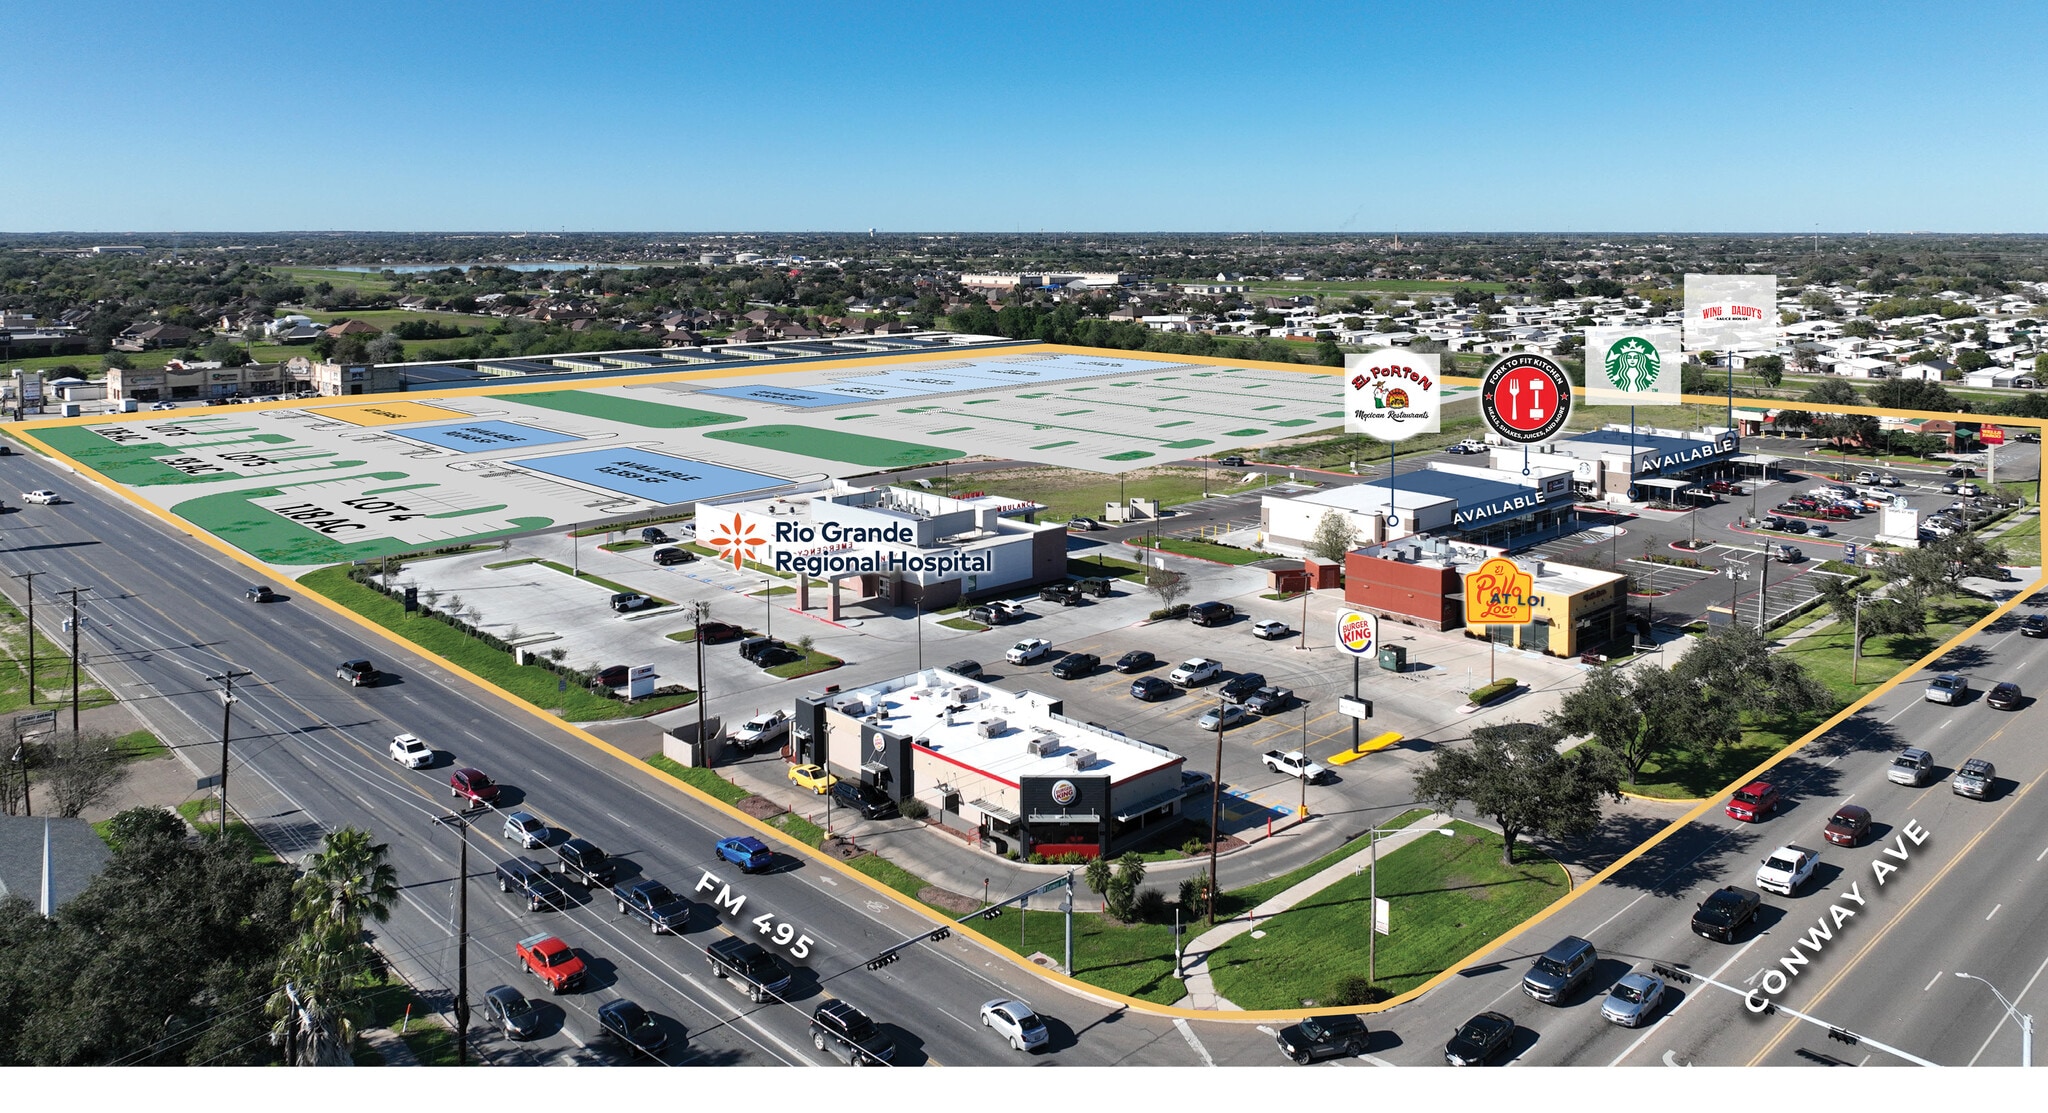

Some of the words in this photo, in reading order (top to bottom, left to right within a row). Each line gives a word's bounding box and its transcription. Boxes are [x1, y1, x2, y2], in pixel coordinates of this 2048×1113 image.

[1342, 620, 1368, 634] BURGER
[1344, 628, 1372, 644] KING
[1056, 791, 1074, 800] KING
